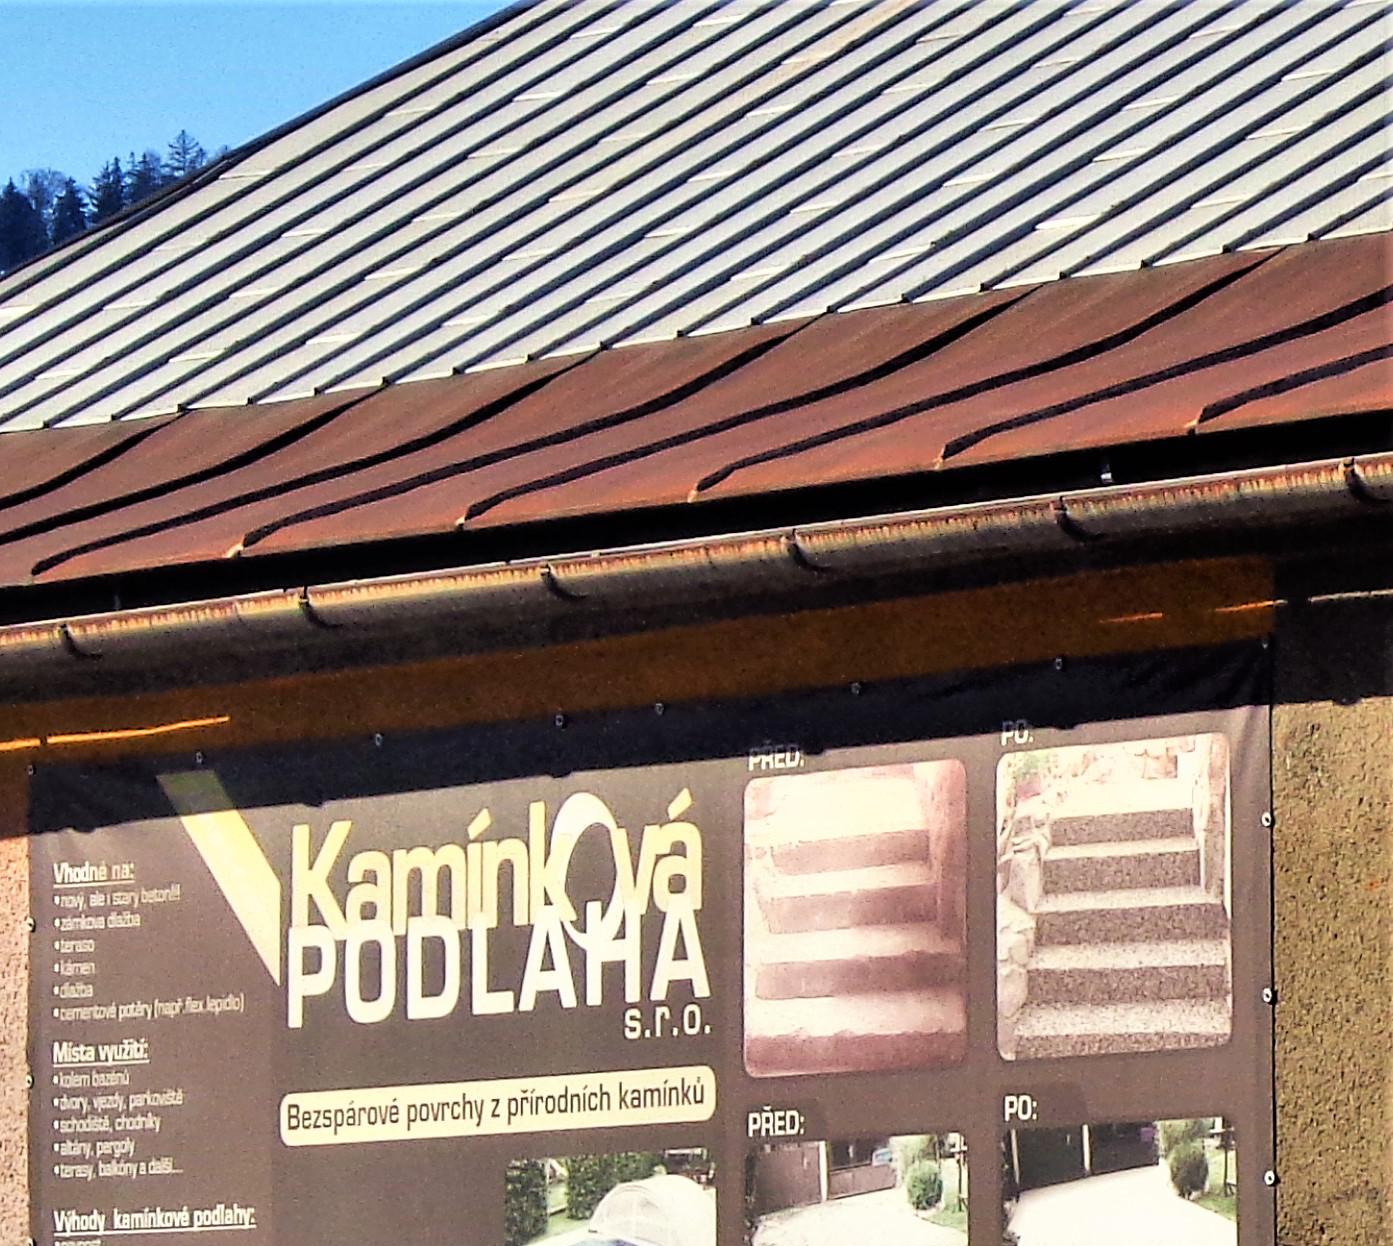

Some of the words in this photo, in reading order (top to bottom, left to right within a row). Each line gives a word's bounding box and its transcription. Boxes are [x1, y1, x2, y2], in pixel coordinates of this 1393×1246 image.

[53, 861, 107, 884] Vhodné
[111, 862, 135, 880] na:
[108, 911, 141, 929] dlažba
[287, 900, 712, 1029] PODLAHA
[623, 1003, 712, 1041] s.r.o.
[53, 1041, 96, 1064] Místa
[97, 1037, 148, 1065] využití:
[59, 1070, 90, 1088] kolem
[287, 1098, 400, 1136] Bezspárové
[407, 1092, 484, 1132] povrchy
[491, 1098, 501, 1118] z
[507, 1083, 611, 1126] přírodních
[618, 1076, 705, 1110] kamínků
[1004, 1094, 1038, 1122] PO:
[747, 1105, 806, 1137] PŘED:
[53, 1208, 105, 1233] Výhody
[113, 1205, 190, 1230] kamínkové
[193, 1203, 256, 1228] podlahy:
